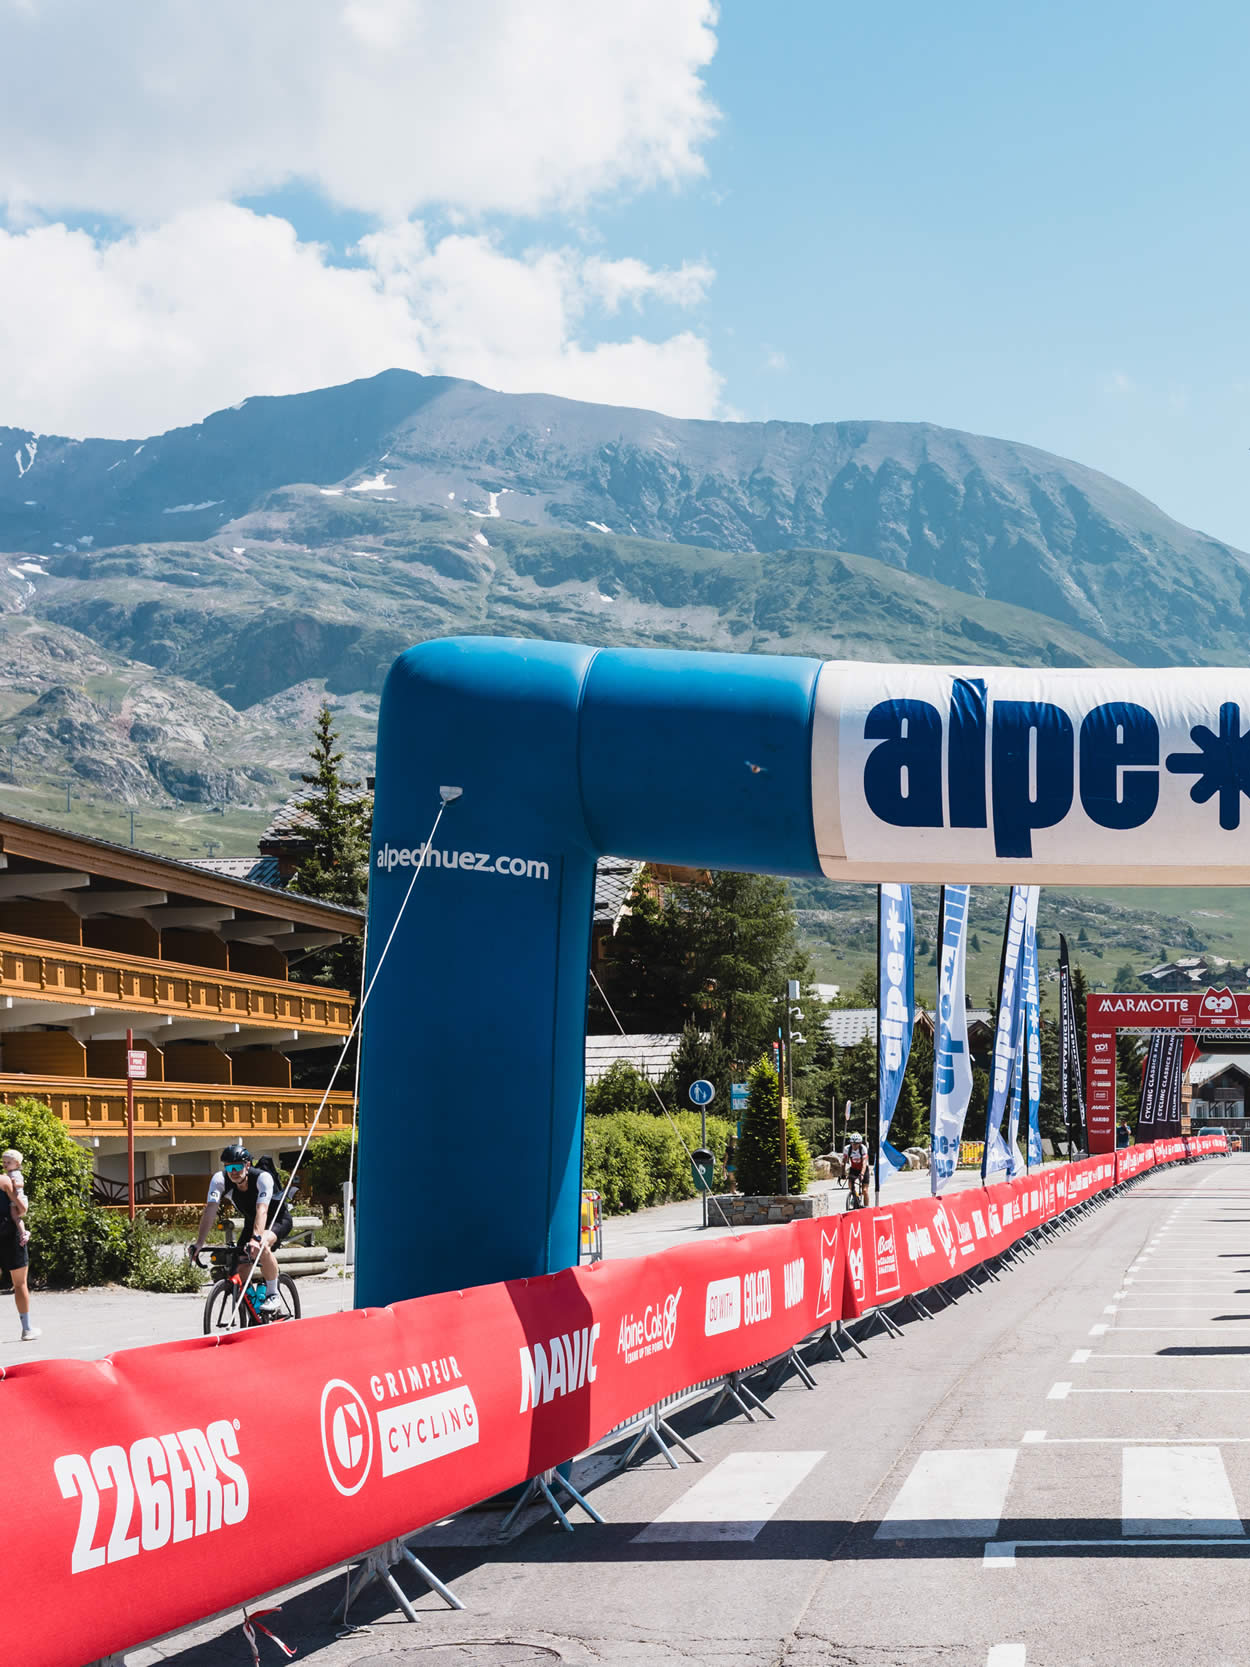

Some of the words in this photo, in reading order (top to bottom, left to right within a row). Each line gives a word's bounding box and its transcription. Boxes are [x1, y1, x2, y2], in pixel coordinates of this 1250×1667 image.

[376, 842, 549, 880] alpedhuez.com
[617, 1314, 643, 1364] Alpine
[370, 1356, 462, 1401] GRIMPEUR
[519, 1323, 601, 1414] MAVIC
[388, 1403, 474, 1453] CYCLING
